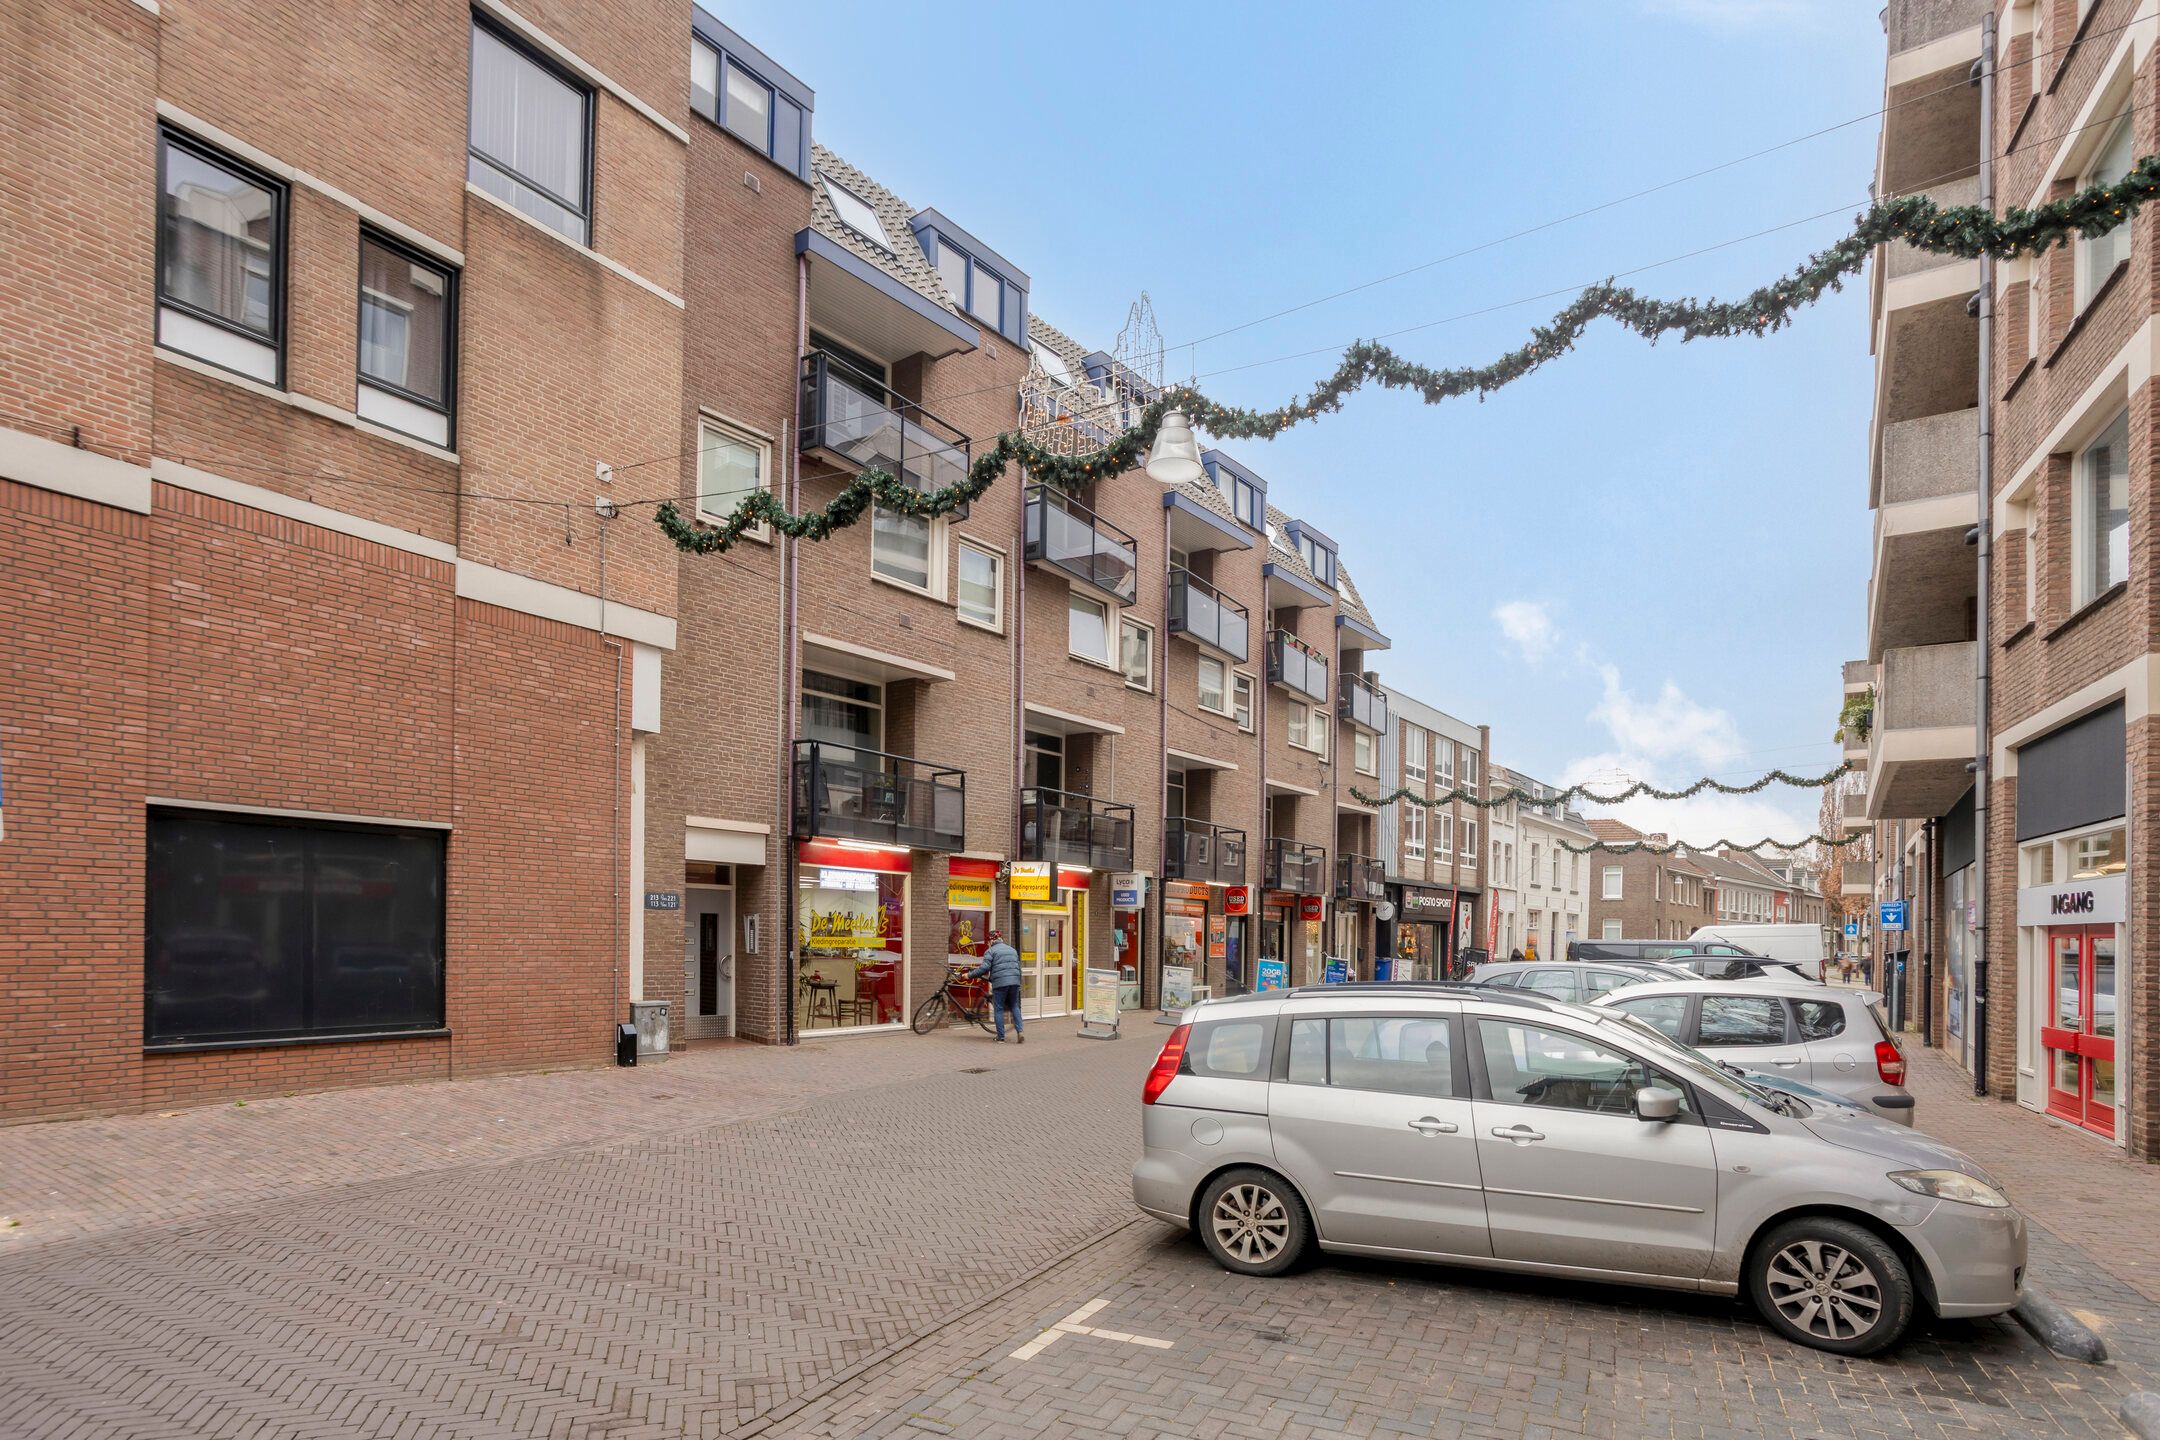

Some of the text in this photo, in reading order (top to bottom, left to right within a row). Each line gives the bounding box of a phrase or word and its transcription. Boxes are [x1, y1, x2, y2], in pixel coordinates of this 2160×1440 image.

[949, 882, 990, 894] edingreparatie
[1011, 883, 1049, 893] Kledingreparatie
[650, 900, 659, 908] 113
[1419, 896, 1452, 908] POSNO SPORT
[2050, 890, 2094, 915] INGANG
[811, 909, 827, 932] De
[811, 938, 857, 947] Kledingreparatie
[1262, 967, 1281, 976] 20GB
